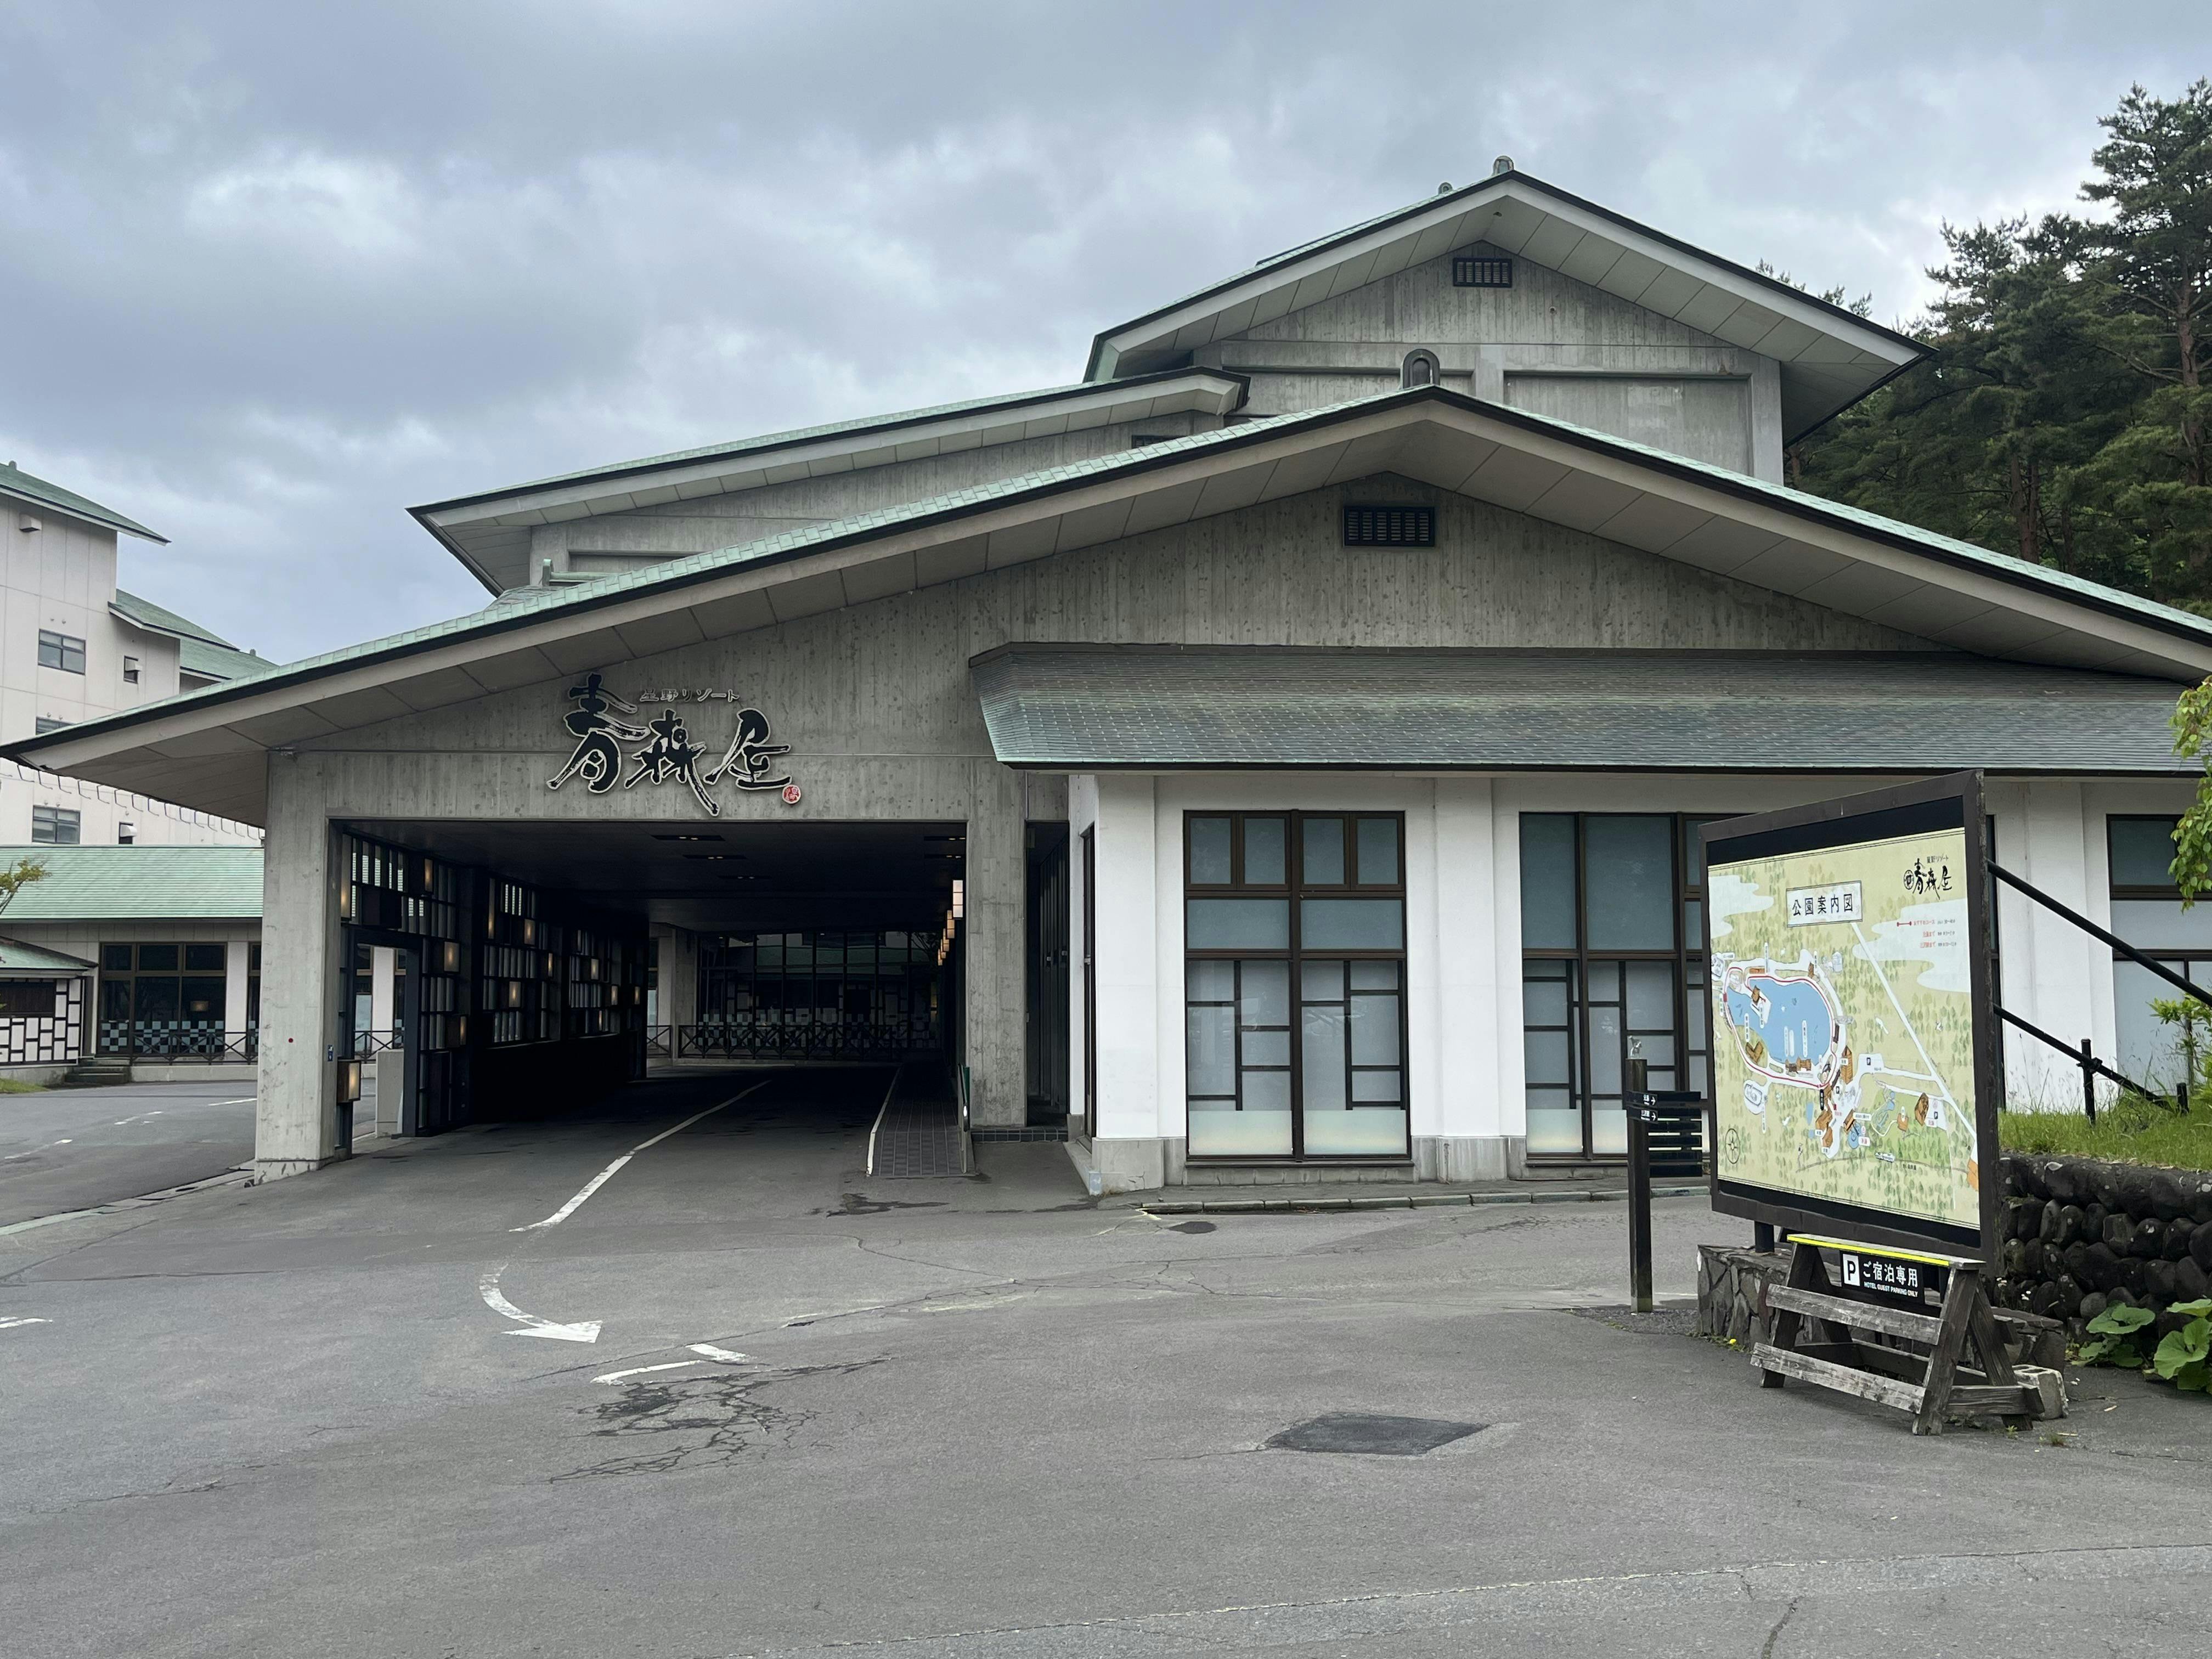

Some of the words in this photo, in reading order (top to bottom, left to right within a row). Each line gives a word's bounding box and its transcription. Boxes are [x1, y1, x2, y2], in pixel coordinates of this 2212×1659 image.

[640, 688, 740, 703] 星野リゾート
[546, 672, 792, 816] 青森屋
[1792, 893, 1853, 916] 公園案内図
[1847, 1260, 1856, 1281] P
[1863, 1261, 1918, 1288] ご宿泊専用
[1877, 1284, 1890, 1292] GUEST
[1891, 1286, 1907, 1295] PARKING
[1908, 1289, 1918, 1297] ONLY
